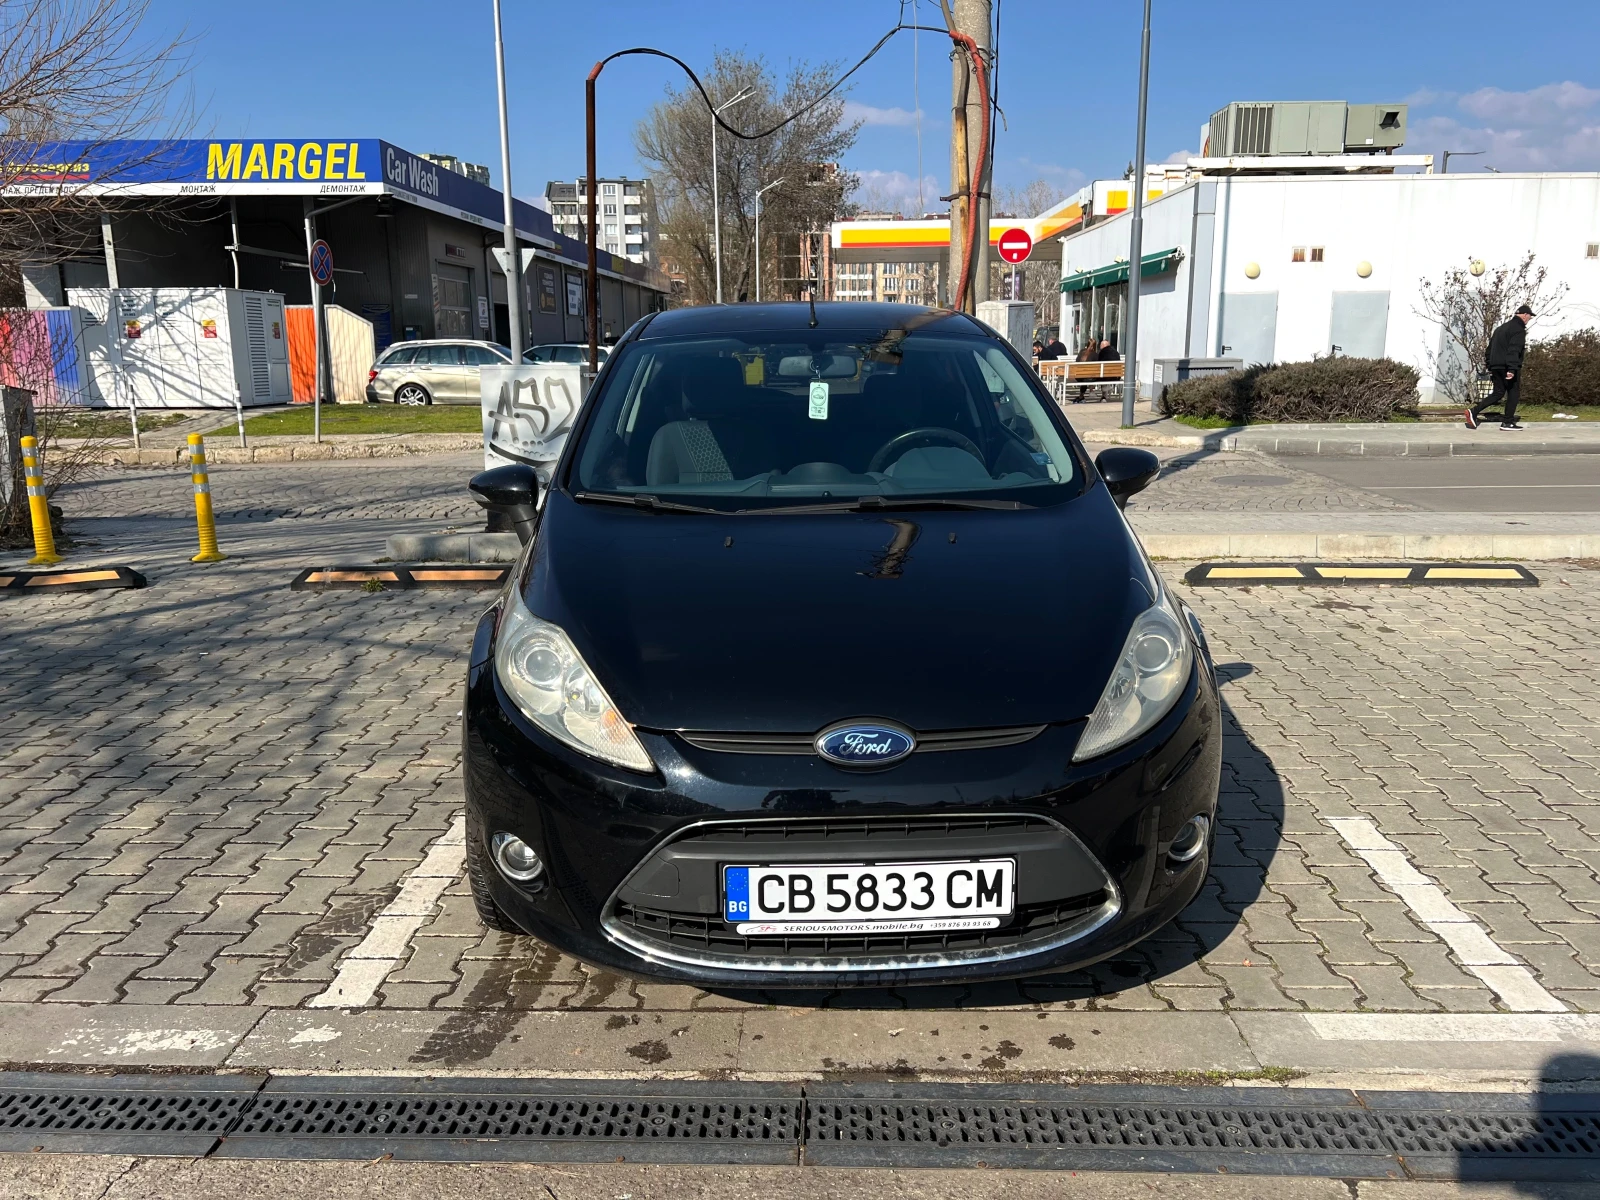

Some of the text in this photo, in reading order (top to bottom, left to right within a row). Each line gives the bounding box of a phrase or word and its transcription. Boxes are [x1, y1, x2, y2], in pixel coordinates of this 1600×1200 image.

[206, 142, 366, 180] MARGEL
[386, 147, 407, 184] Car
[408, 156, 439, 197] Wash
[181, 184, 216, 193] МОНТАЖ
[320, 184, 366, 193] ДЕМОНТАЖ
[839, 733, 891, 755] Ford
[758, 869, 1004, 914] CB 5833 CM
[728, 901, 748, 913] BG
